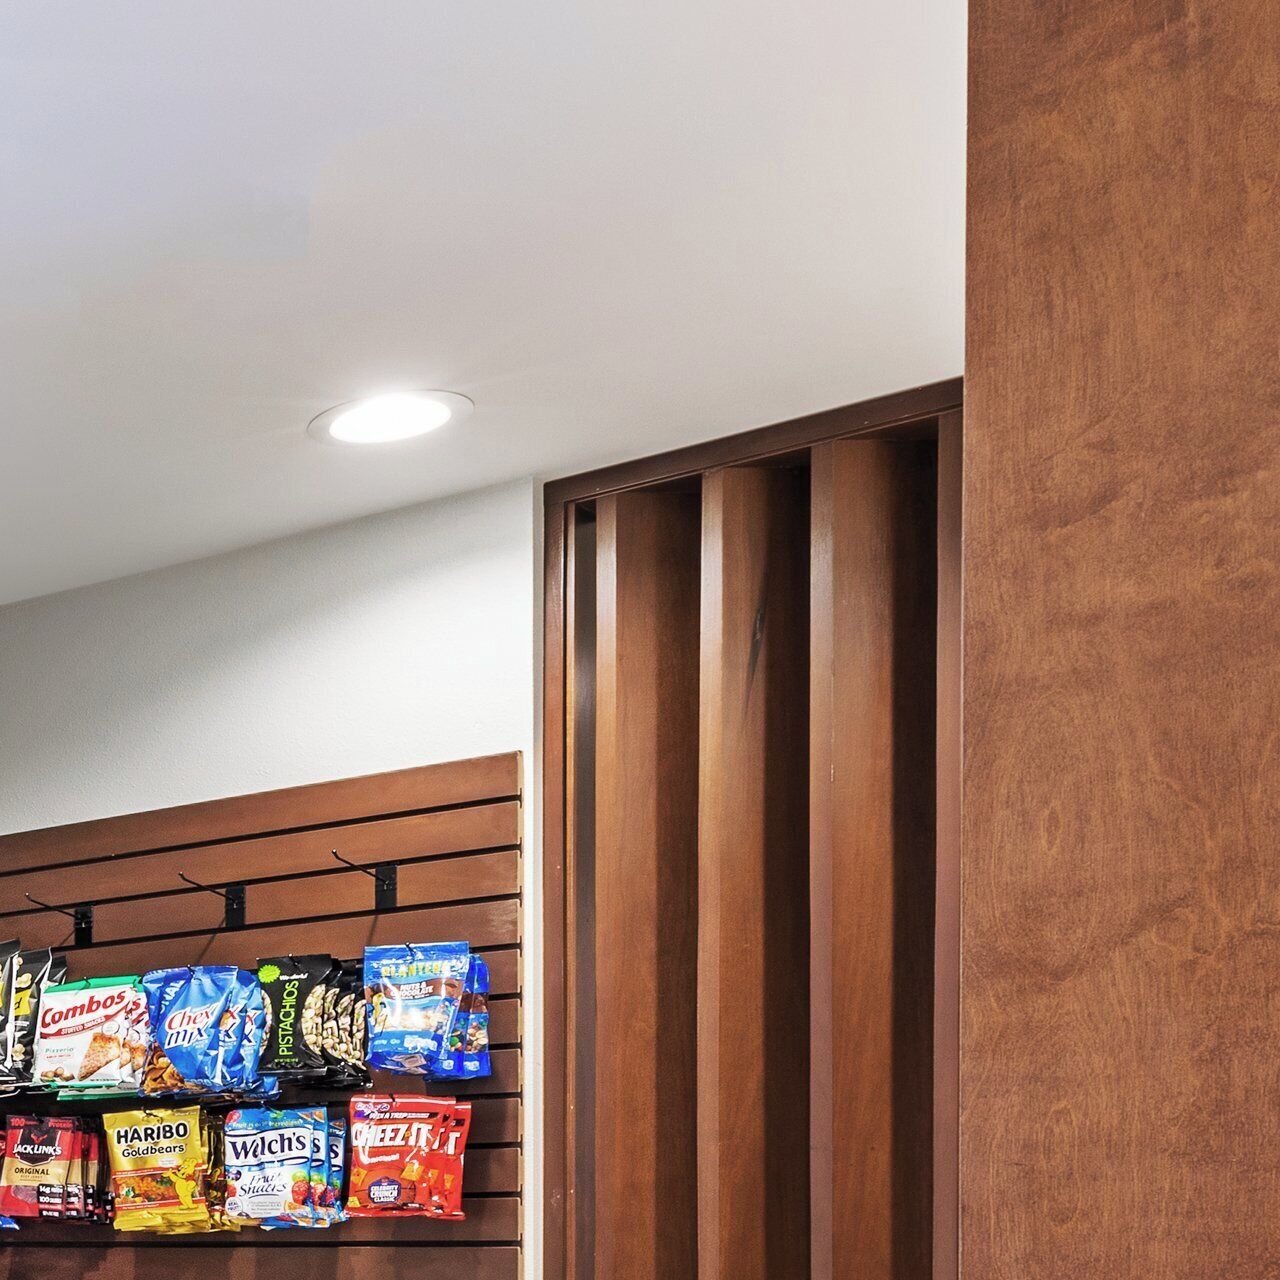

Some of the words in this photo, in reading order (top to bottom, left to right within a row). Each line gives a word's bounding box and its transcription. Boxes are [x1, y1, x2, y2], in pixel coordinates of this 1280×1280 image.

[42, 990, 126, 1028] Combos
[167, 1008, 210, 1031] Chex
[278, 980, 300, 1056] PISTACHIOS
[84, 1016, 105, 1029] SNACKS
[116, 1121, 189, 1144] HARIBO
[13, 1143, 33, 1154] JACK
[122, 1142, 185, 1159] Goldbears
[228, 1132, 307, 1160] Welch's
[14, 1167, 50, 1175] ORIGINAL
